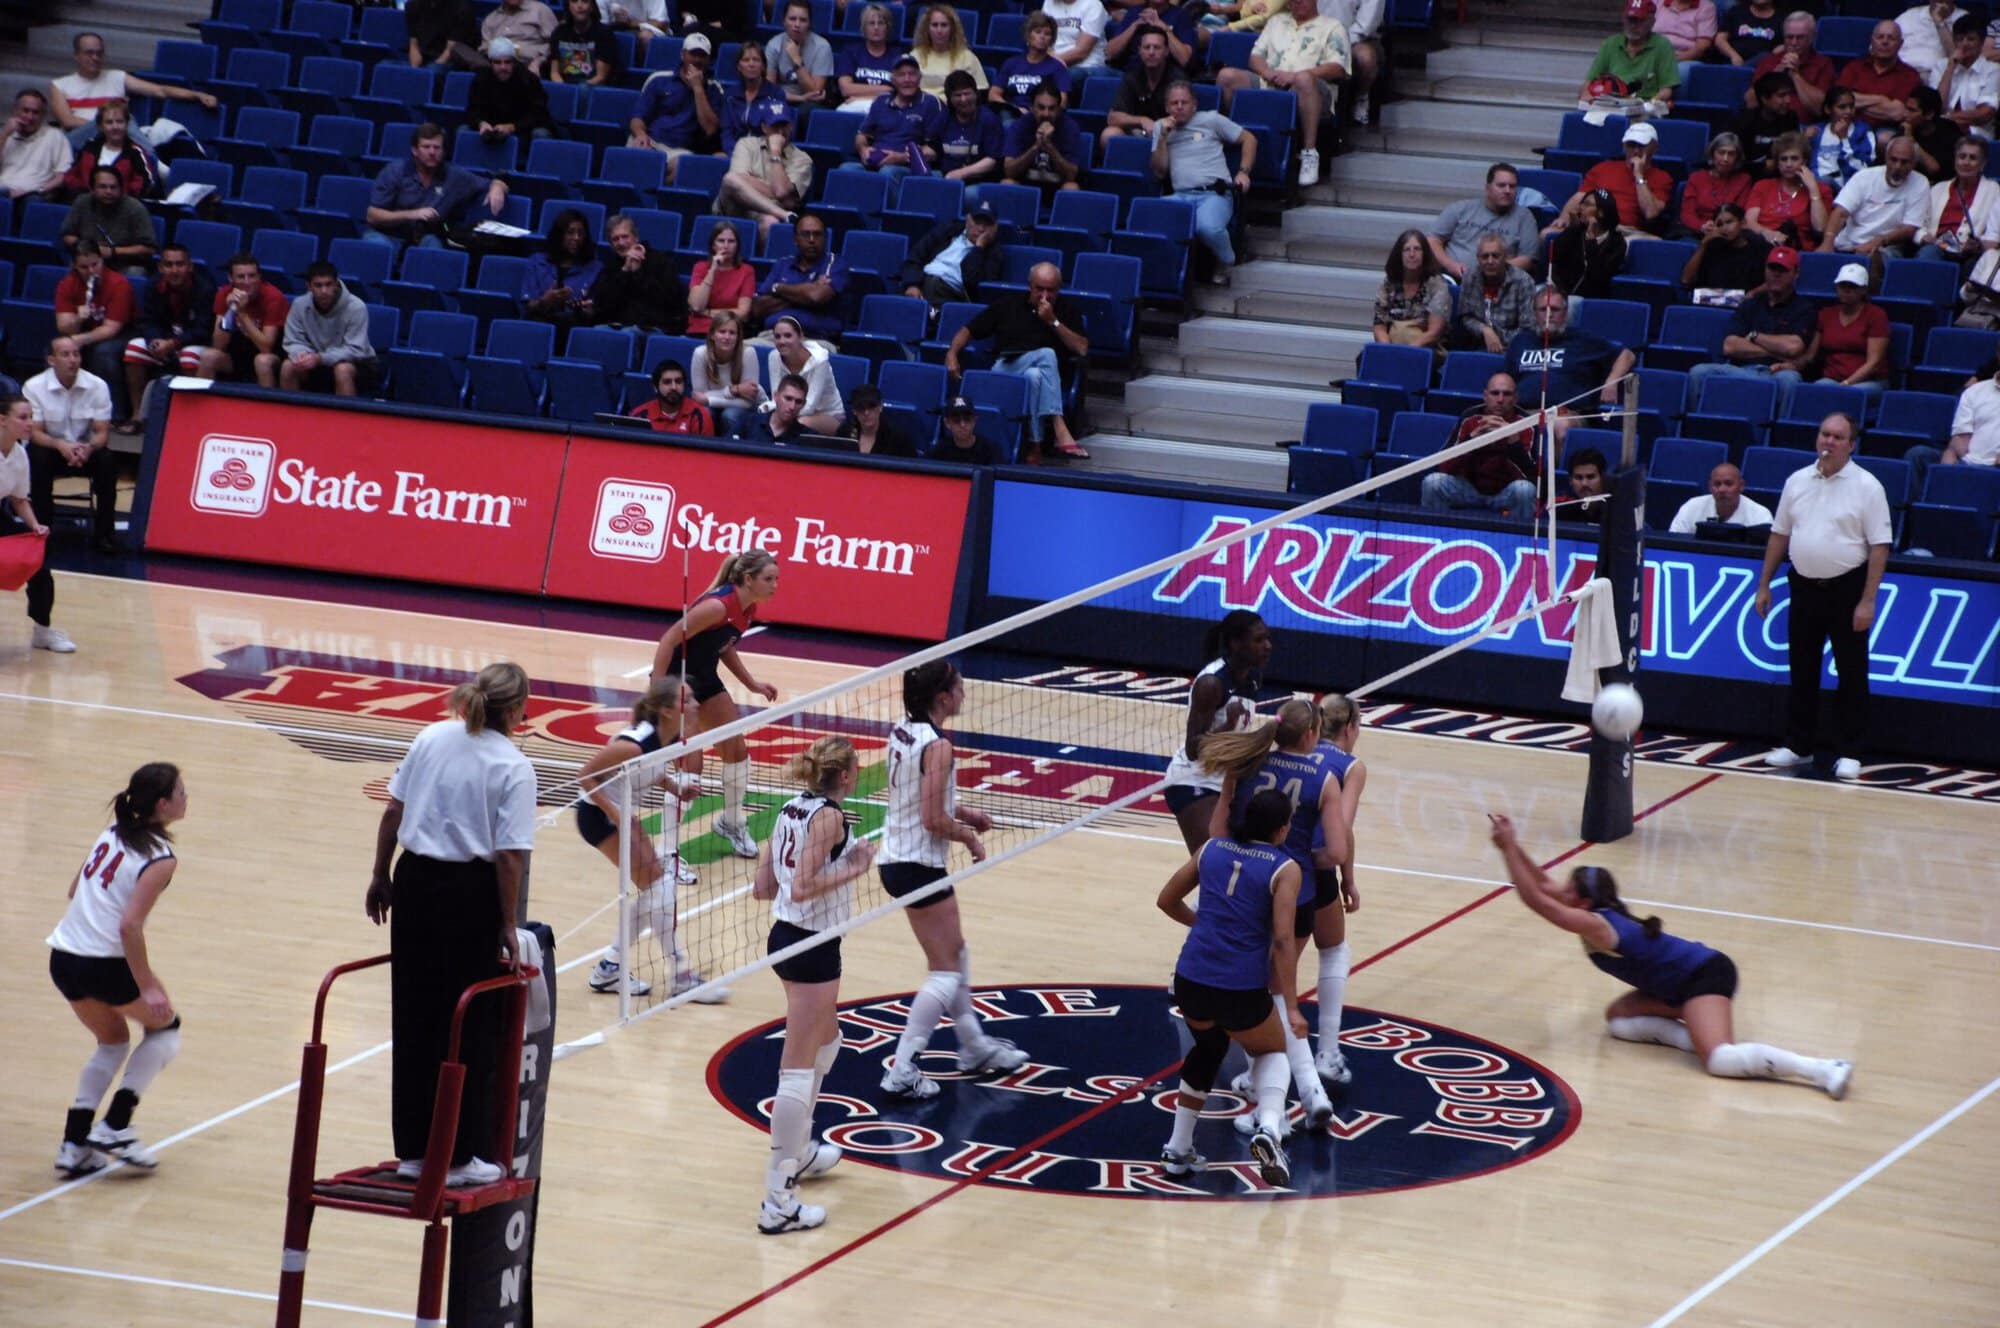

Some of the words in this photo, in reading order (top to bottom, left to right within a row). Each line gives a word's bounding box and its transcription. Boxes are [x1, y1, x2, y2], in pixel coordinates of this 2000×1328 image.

[1520, 350, 1565, 365] UMC
[211, 446, 236, 454] STATE
[241, 449, 264, 457] FARM
[203, 492, 257, 505] INSURANCE
[272, 457, 382, 513] State
[388, 470, 512, 528] Farm
[611, 490, 635, 498] STATE
[640, 493, 663, 502] FARM
[601, 537, 655, 550] INSURANCE
[672, 503, 782, 558] State
[788, 515, 914, 576] Farm
[1620, 504, 1645, 778] WILDCS
[1661, 560, 2000, 693] VOLL
[1002, 666, 1192, 701] 199
[1253, 771, 1304, 814] 24
[83, 842, 125, 890] 34
[779, 825, 796, 869] 12
[1215, 840, 1276, 862] WASHINGTON
[1226, 860, 1243, 897] 1
[1308, 1018, 1555, 1151] BOBBI
[757, 1092, 1298, 1196] COURT
